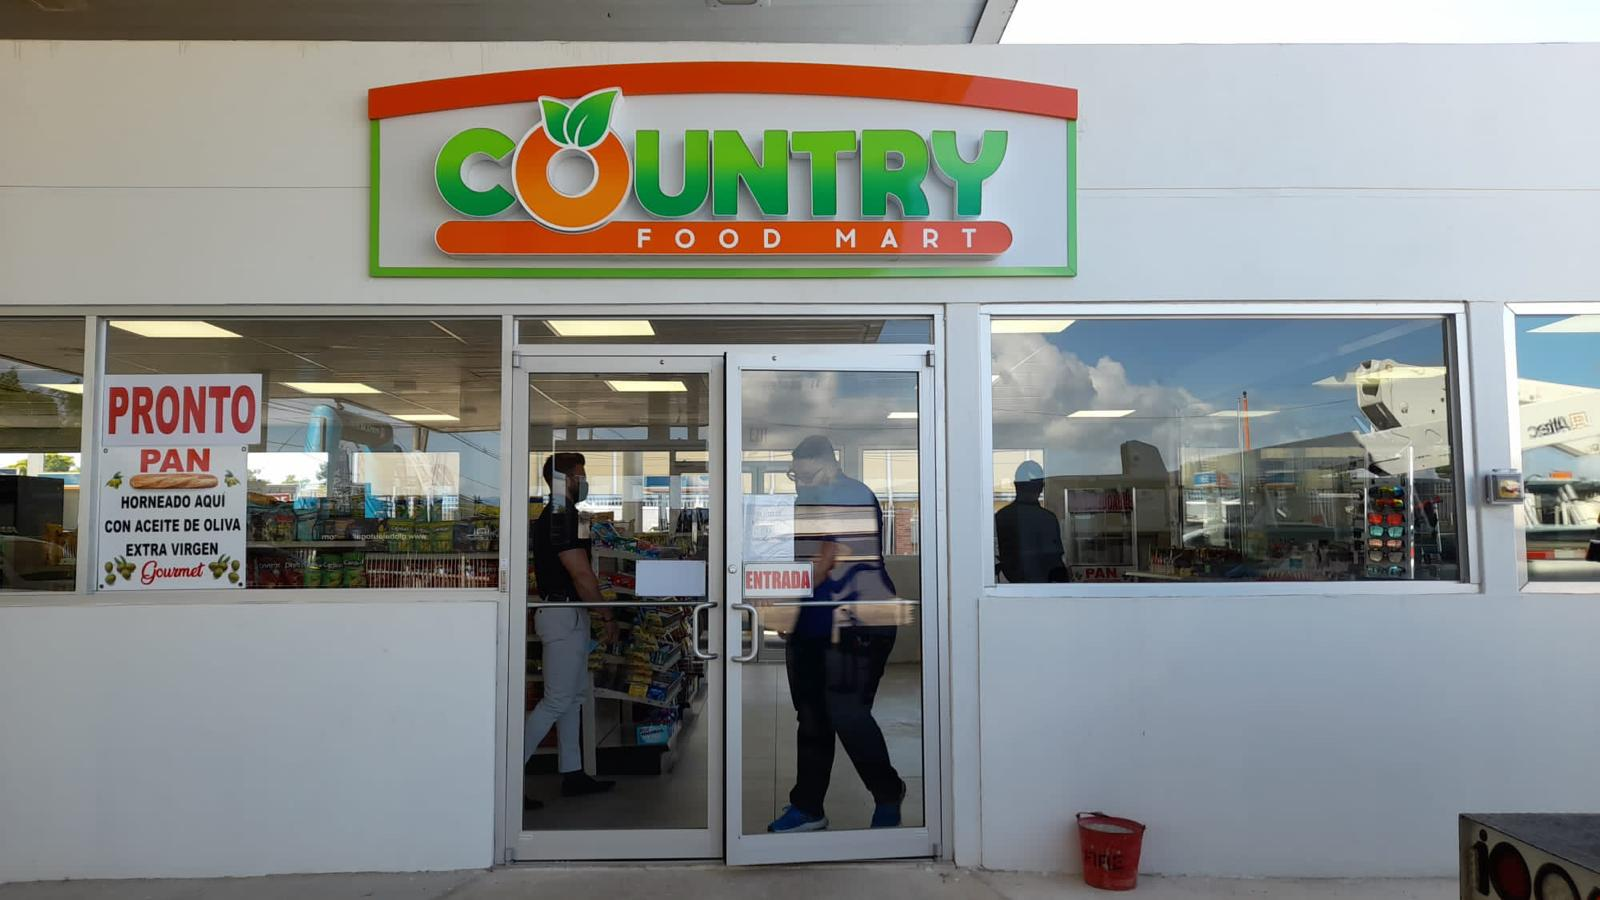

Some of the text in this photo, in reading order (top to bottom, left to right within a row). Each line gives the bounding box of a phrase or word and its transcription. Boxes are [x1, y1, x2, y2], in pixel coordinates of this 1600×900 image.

[434, 119, 1009, 232] COUNTRY
[637, 228, 977, 248] FOOD MART
[108, 384, 256, 435] PRONTO
[140, 448, 211, 473] PAN
[121, 495, 191, 509] HORNEADO
[104, 518, 241, 533] CON ACEITE DE OLIVA
[126, 542, 218, 556] EXTRA VIRGEN
[140, 560, 206, 585] Gourmet
[745, 570, 811, 590] ENTRADA
[1085, 567, 1118, 579] PAN
